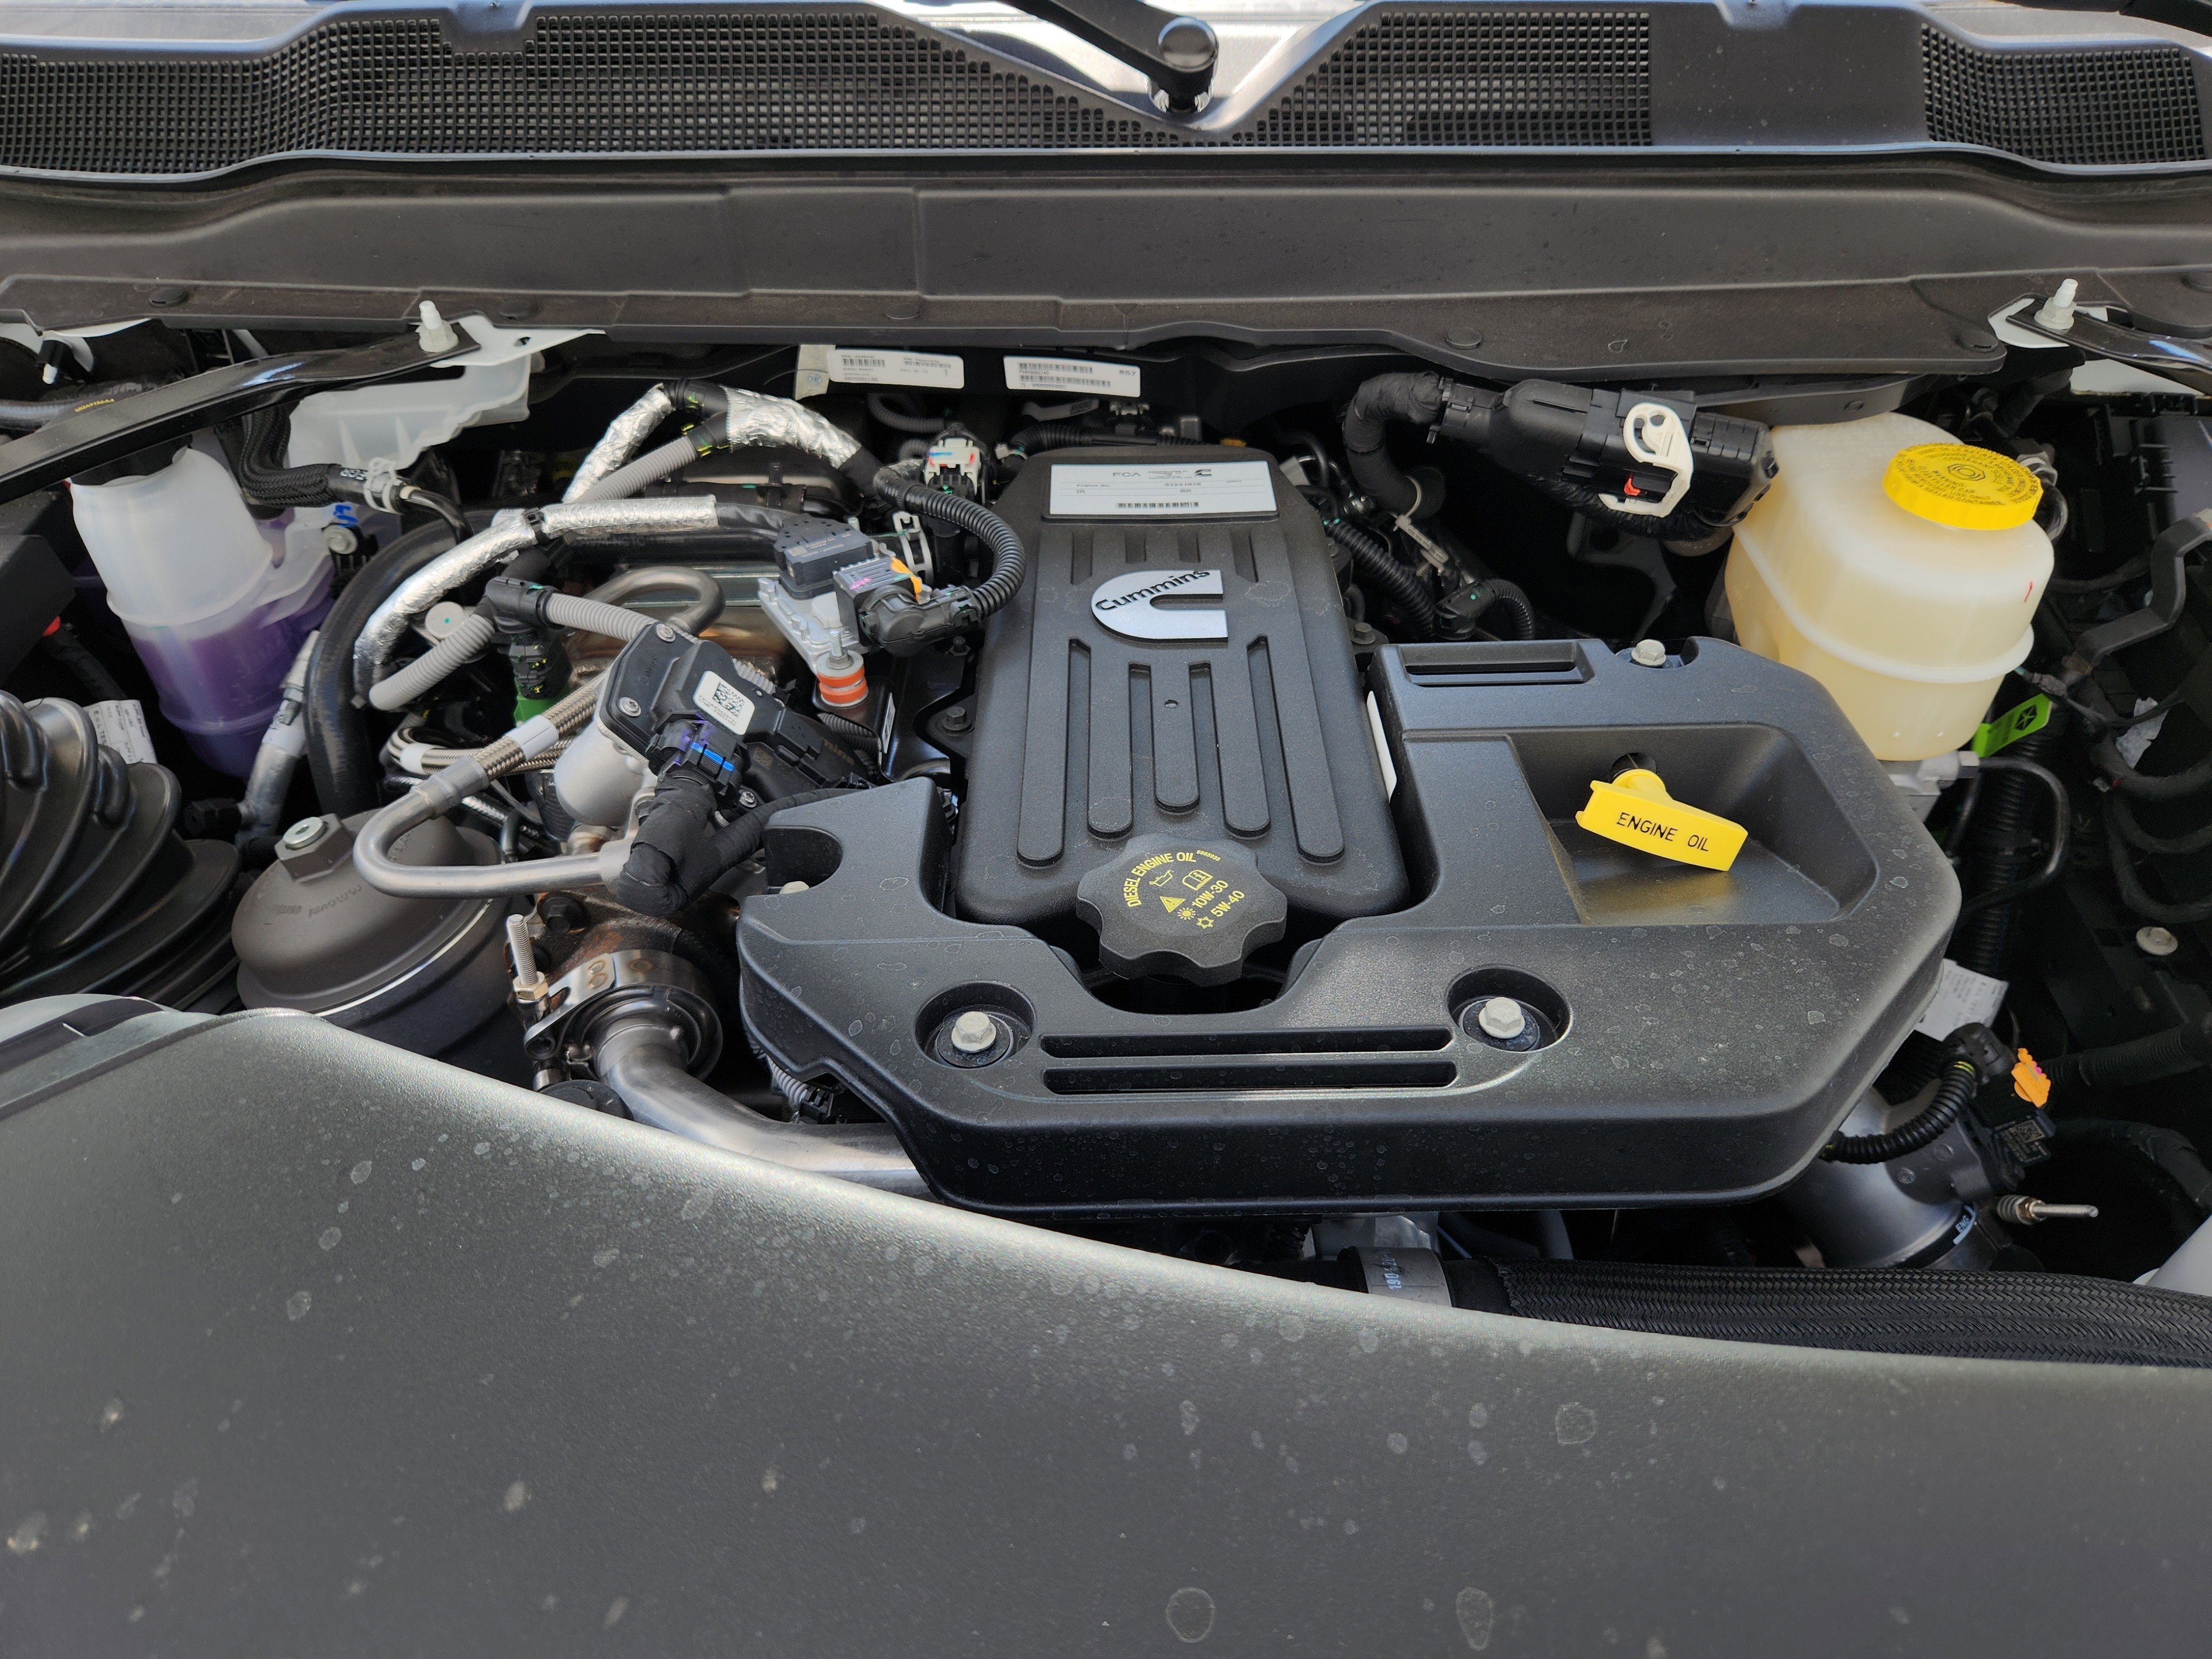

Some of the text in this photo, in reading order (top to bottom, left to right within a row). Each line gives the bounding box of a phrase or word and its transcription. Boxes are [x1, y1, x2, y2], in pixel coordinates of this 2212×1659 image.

[1095, 571, 1210, 611] Cummins
[1616, 812, 1709, 852] ENGINE OIL
[1123, 852, 1197, 907] DIESEL ENGINE OIL
[1192, 880, 1229, 908] 10W-30
[1210, 890, 1245, 918] 5W-40
